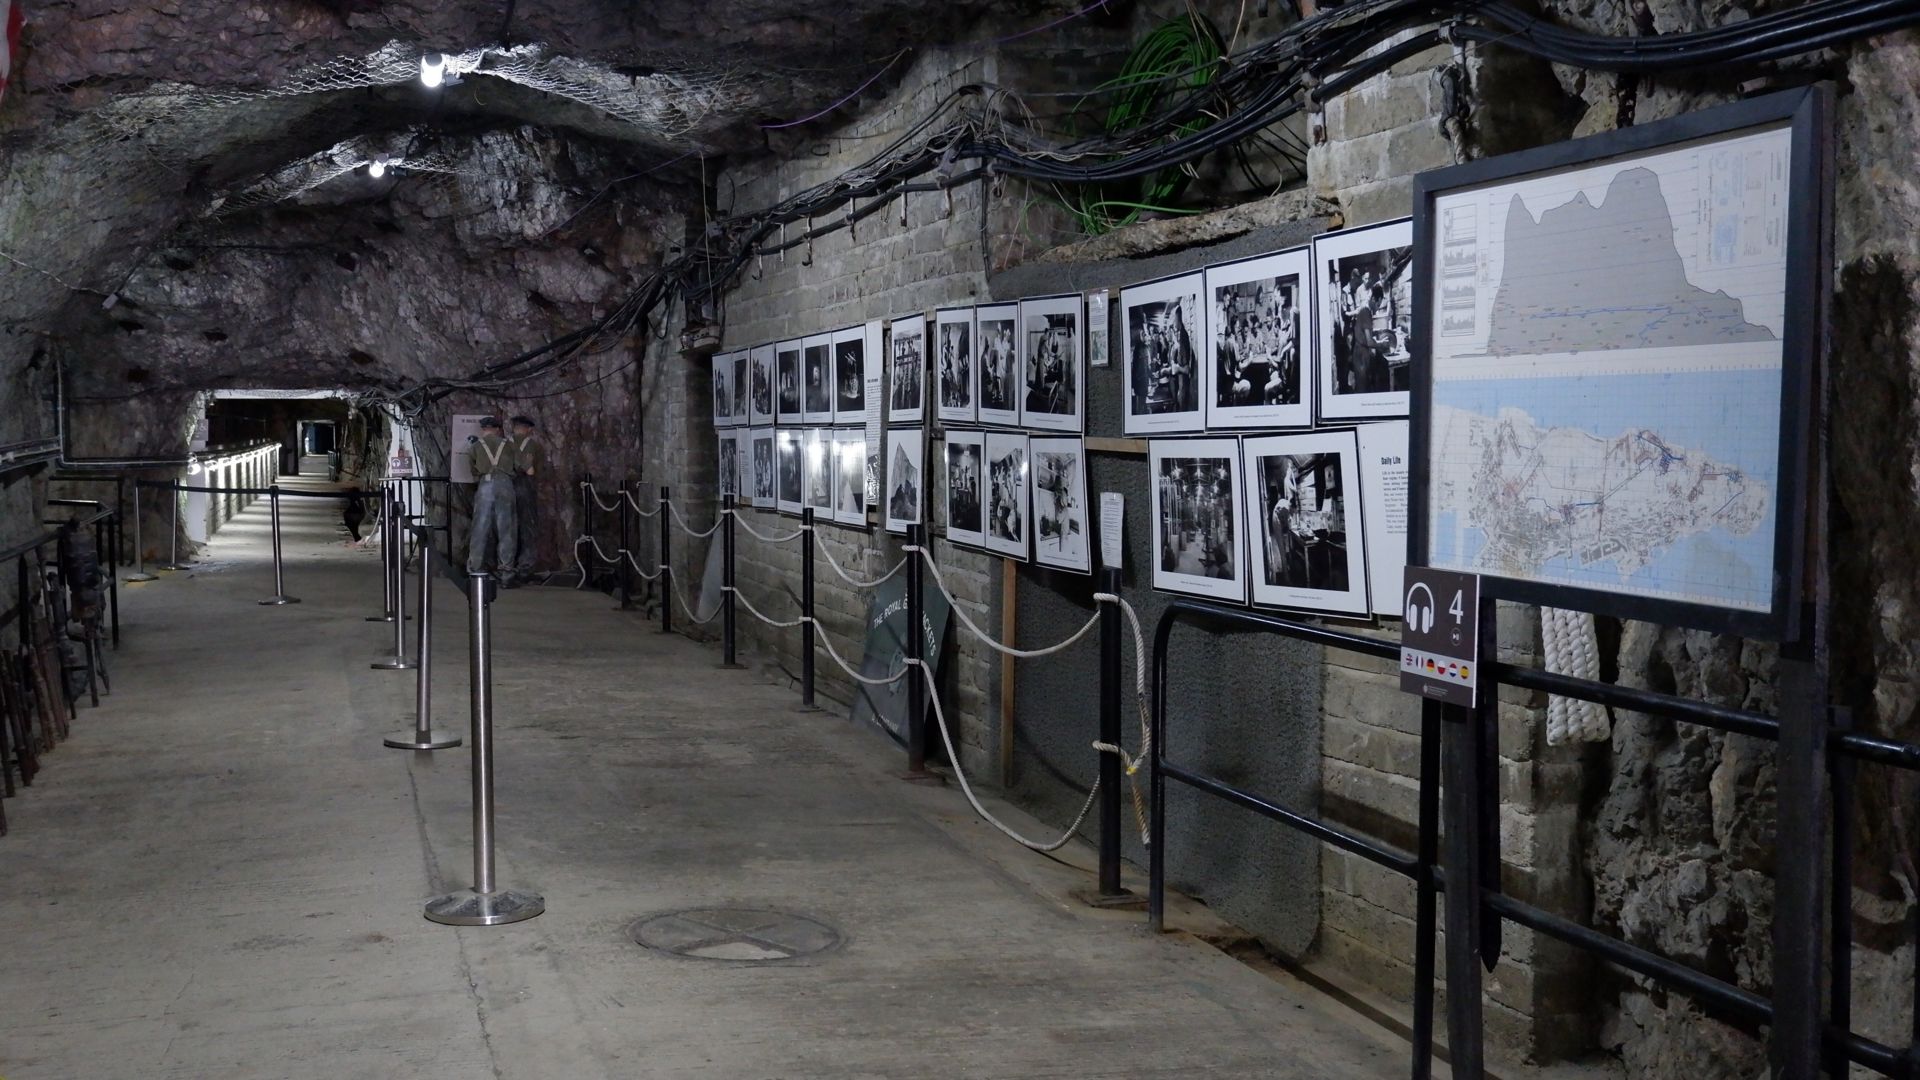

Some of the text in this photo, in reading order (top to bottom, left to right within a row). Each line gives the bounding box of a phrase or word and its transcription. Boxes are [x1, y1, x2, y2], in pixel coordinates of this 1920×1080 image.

[1381, 456, 1392, 466] Daily
[873, 612, 884, 629] THE
[883, 599, 902, 619] ROYAL
[1448, 589, 1464, 625] 4
